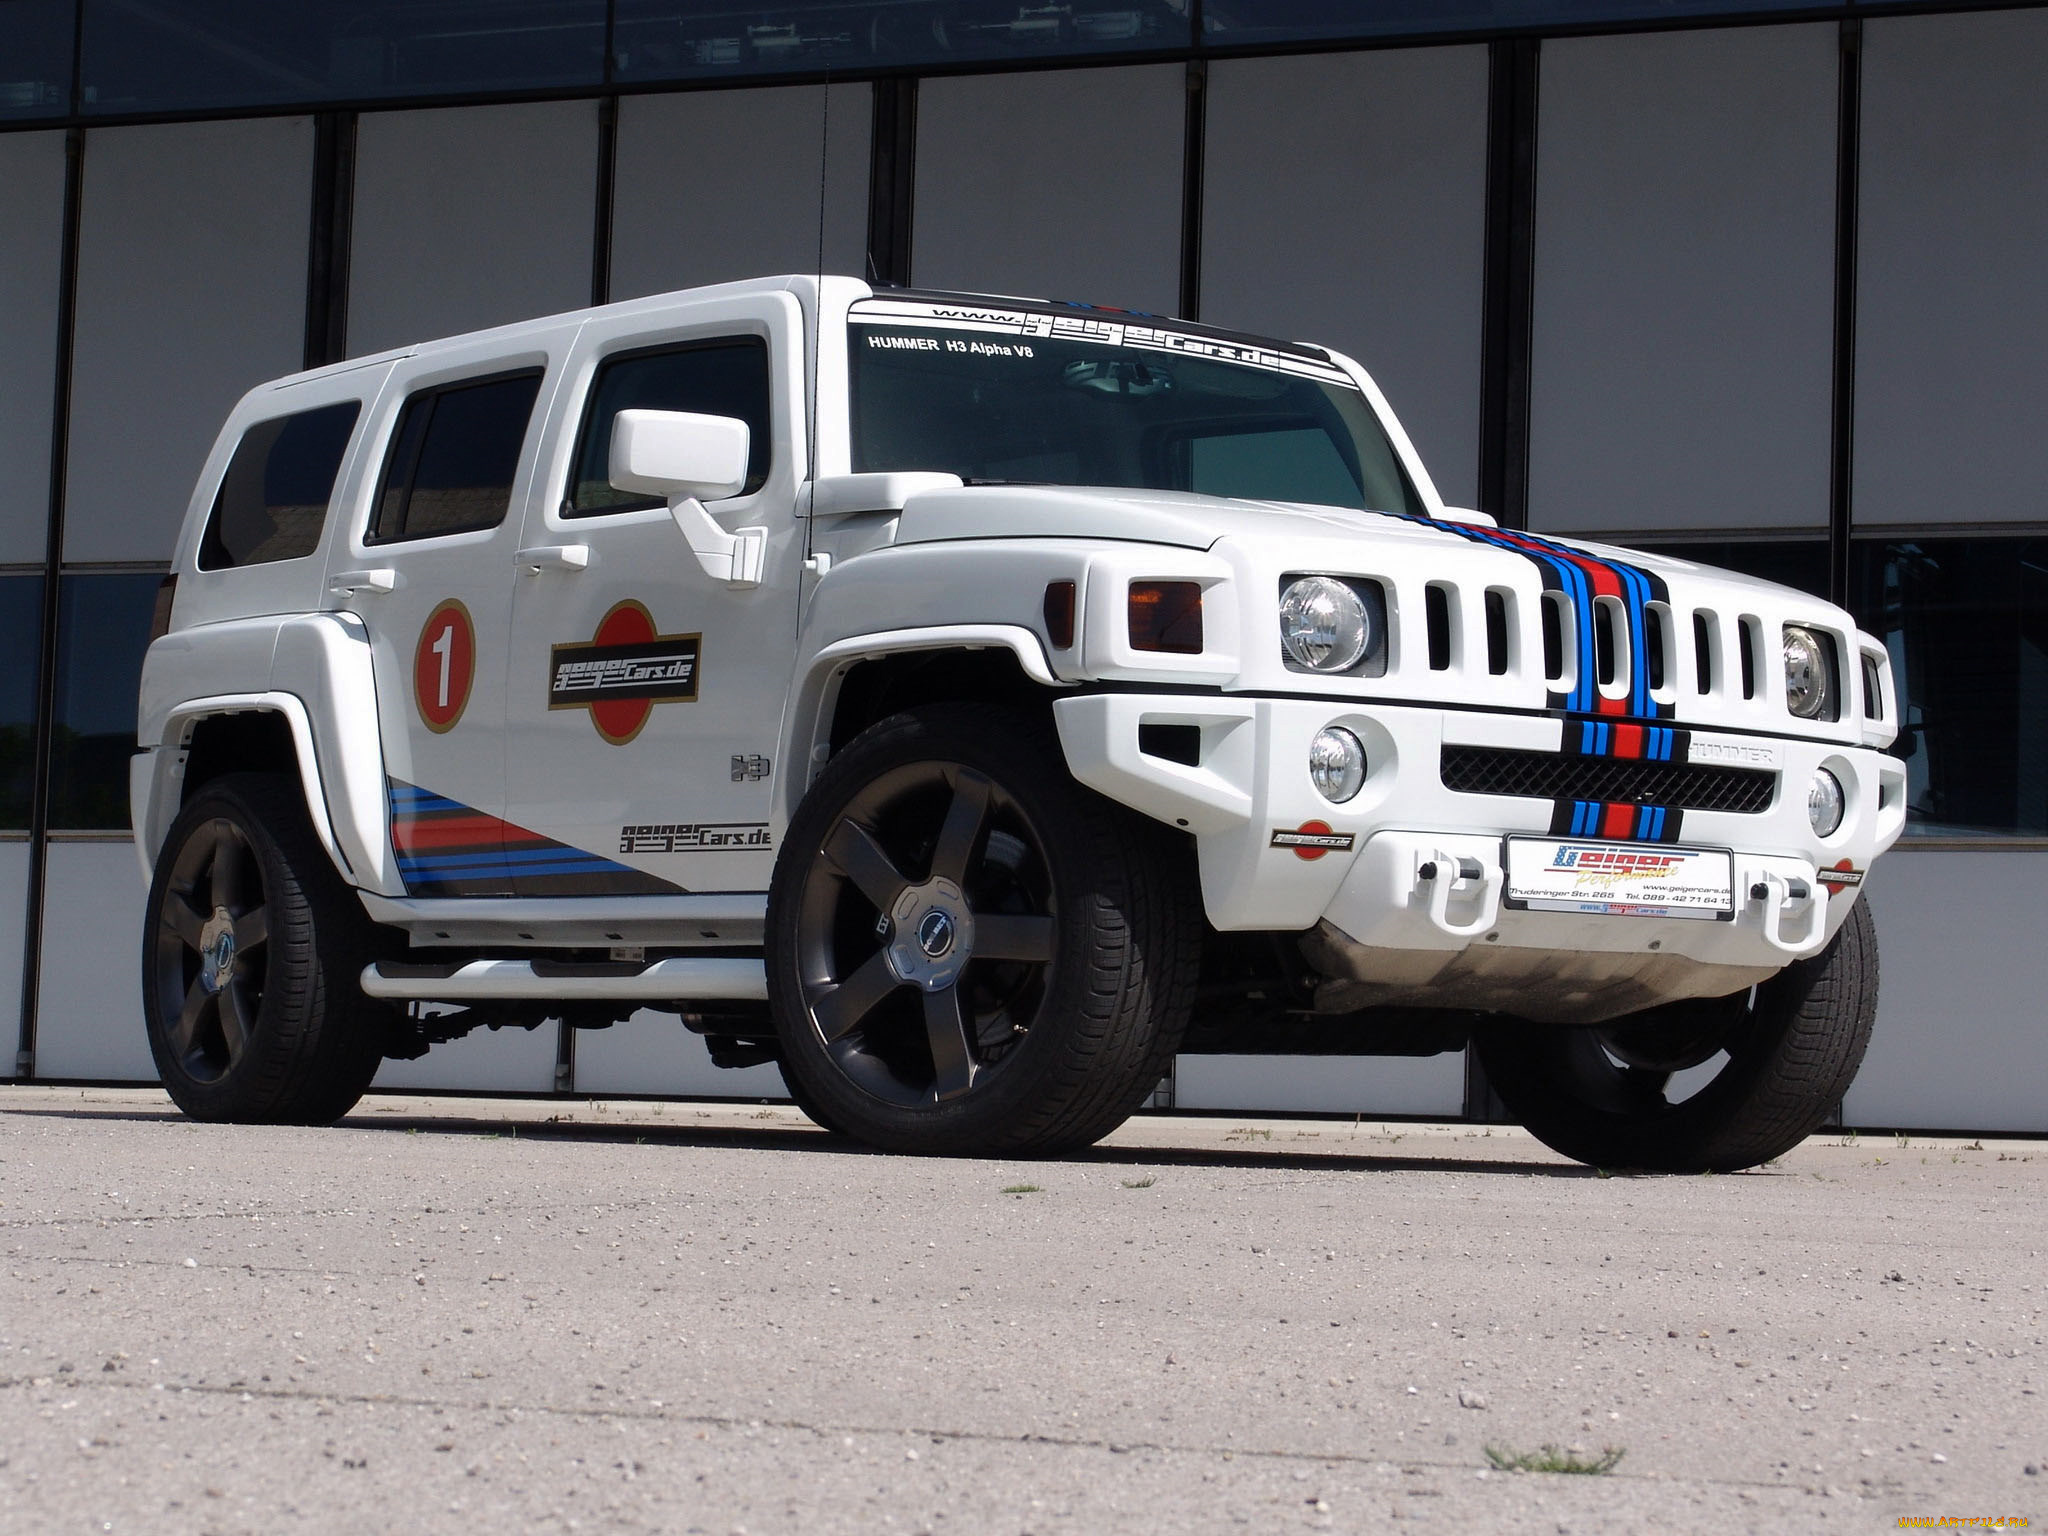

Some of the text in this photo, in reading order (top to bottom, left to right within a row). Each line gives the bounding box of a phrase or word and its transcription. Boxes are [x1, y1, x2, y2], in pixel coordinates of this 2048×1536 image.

[867, 335, 1034, 359] HUMMER H3 Alpha V8
[432, 625, 453, 707] 1
[1509, 887, 1570, 898] Truderinger
[1592, 891, 1615, 899] 265
[1642, 884, 1731, 895] www.geigercars.de
[1642, 893, 1666, 901] 089
[1672, 895, 1687, 903] 42
[1689, 896, 1702, 904] 71
[1703, 897, 1718, 905] 64
